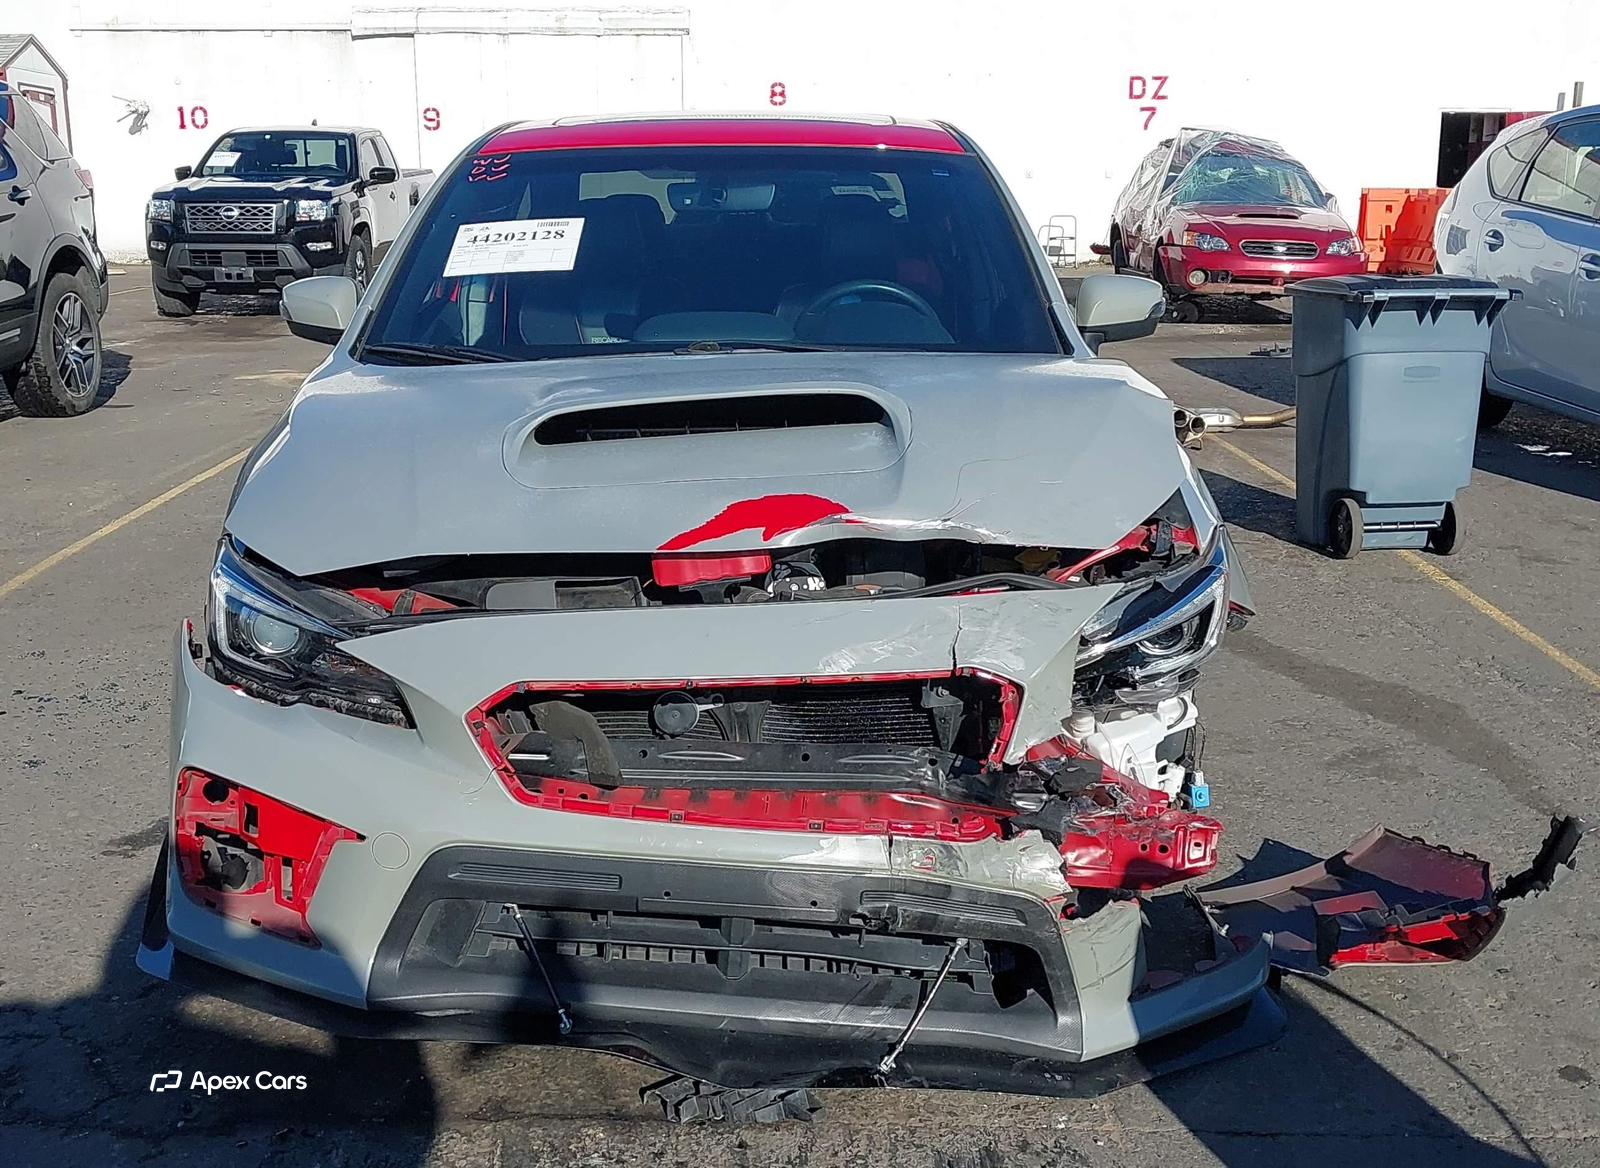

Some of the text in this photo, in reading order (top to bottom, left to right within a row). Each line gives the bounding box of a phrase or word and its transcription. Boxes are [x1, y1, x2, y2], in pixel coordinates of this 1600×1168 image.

[769, 82, 786, 106] 8
[1128, 75, 1169, 100] DZ
[177, 105, 209, 130] 10
[423, 107, 440, 131] 9
[1139, 106, 1157, 131] 7
[466, 229, 566, 244] 44202128
